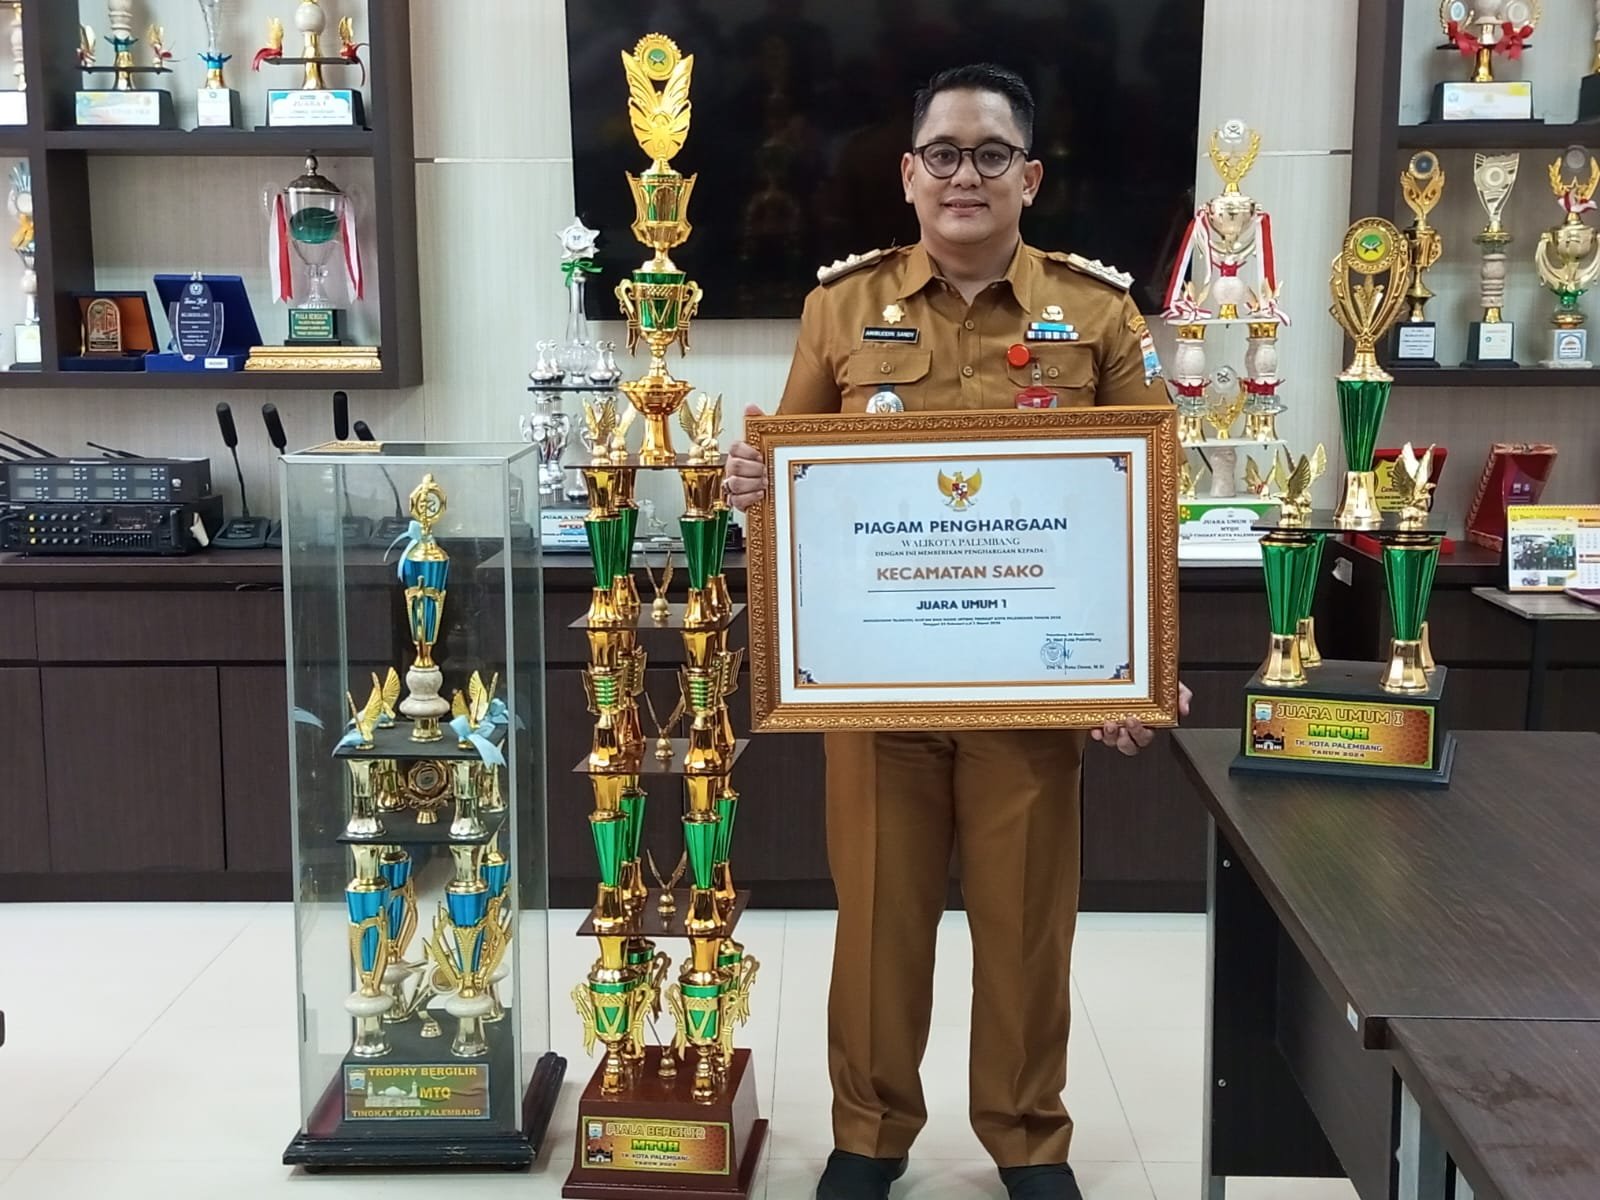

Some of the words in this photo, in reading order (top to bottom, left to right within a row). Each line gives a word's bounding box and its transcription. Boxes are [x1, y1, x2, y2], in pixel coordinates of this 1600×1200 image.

[854, 521, 923, 534] PIAGAM
[930, 518, 1068, 533] PENGHARGAAN
[901, 538, 956, 548] WALIKOTA
[958, 538, 1020, 547] PALEMBANG
[877, 566, 986, 580] KECAMATAN
[992, 564, 1044, 578] SAKO
[916, 600, 958, 610] JUARA
[962, 600, 998, 609] UMUM
[1001, 599, 1006, 608] 1
[1276, 704, 1332, 721] JUARA
[1336, 708, 1390, 724] UMUM
[1308, 723, 1370, 740] MTQH
[1332, 742, 1383, 752] PALEMBANG
[368, 1067, 417, 1076] TROPHY
[420, 1066, 478, 1076] BERGILIR
[420, 1086, 451, 1099] MTQ
[424, 1108, 480, 1116] PALEMBANG
[606, 1122, 644, 1136] PIALA
[646, 1125, 706, 1140] BERGILIR
[632, 1138, 680, 1152] MTQH
